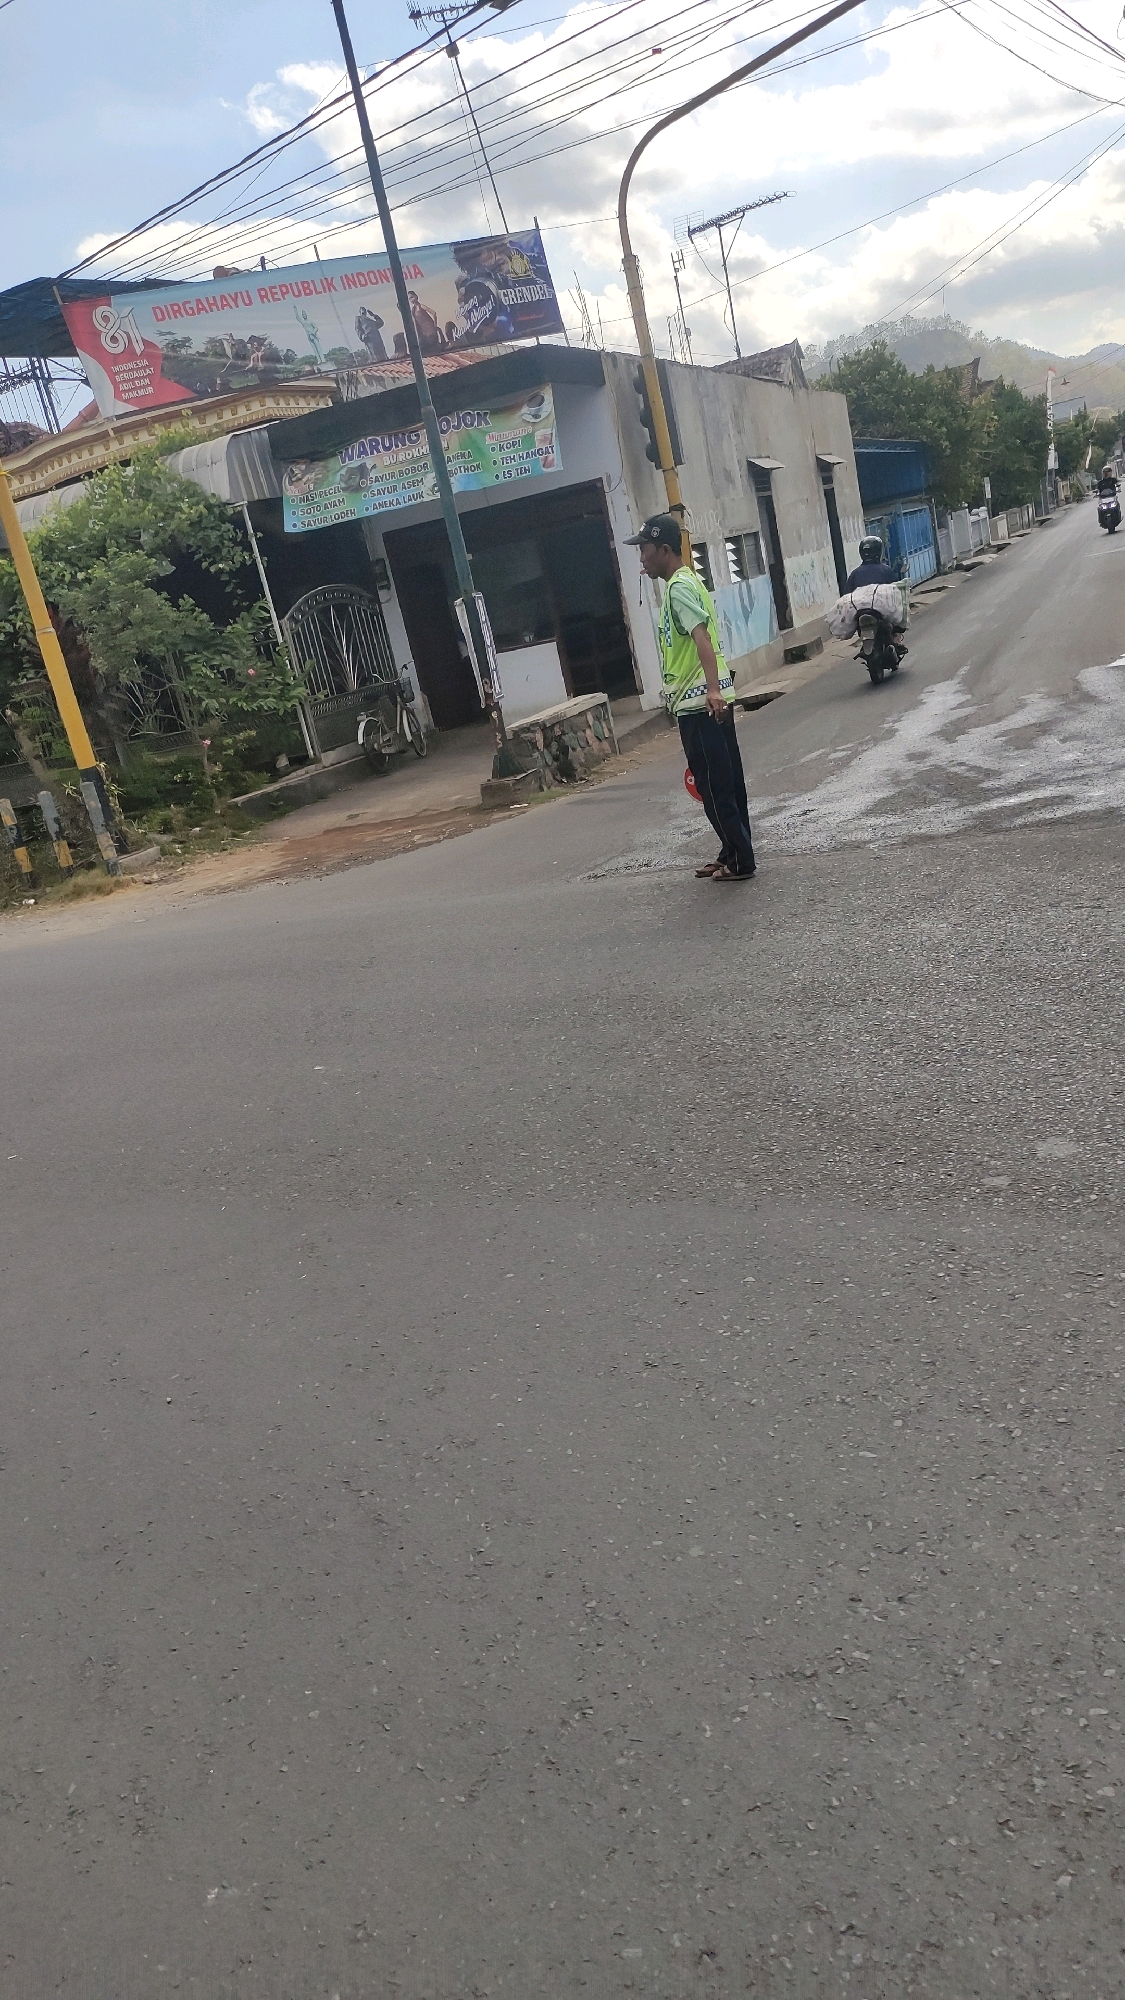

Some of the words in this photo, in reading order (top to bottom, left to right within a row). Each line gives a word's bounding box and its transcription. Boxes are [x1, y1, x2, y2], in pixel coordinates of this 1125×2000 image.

[152, 290, 253, 322] DIRGAHAYU
[257, 276, 338, 304] REPUBLIK
[340, 263, 425, 290] INDONIA
[500, 284, 553, 306] GRENDEL
[92, 305, 146, 356] 81
[111, 359, 149, 373] INDONESIA
[115, 367, 155, 382] BERDAULAT
[119, 381, 136, 391] ADIL
[136, 378, 151, 388] DAN
[122, 387, 155, 400] MAKMUR
[337, 432, 420, 465] WARUNG
[426, 410, 492, 439] OJOK
[498, 440, 521, 453] KOPI
[383, 454, 397, 466] BU
[500, 455, 517, 466] TEH
[518, 445, 555, 459] HANGAT
[369, 471, 396, 485] SAYUR
[398, 461, 429, 478] BOBOR
[448, 461, 482, 478] BOTHOK
[502, 469, 512, 480] ES
[515, 465, 531, 477] TEH
[298, 492, 317, 504] NASI
[319, 485, 342, 498] PECEL
[369, 483, 398, 498] SAYUR
[401, 477, 425, 492] ASEM
[299, 505, 321, 516] SOTO
[323, 497, 346, 511] AYAM
[373, 498, 401, 512] ANEKA
[403, 490, 425, 504] LAUK
[300, 516, 329, 529] SAYUR
[330, 508, 356, 522] LODEH
